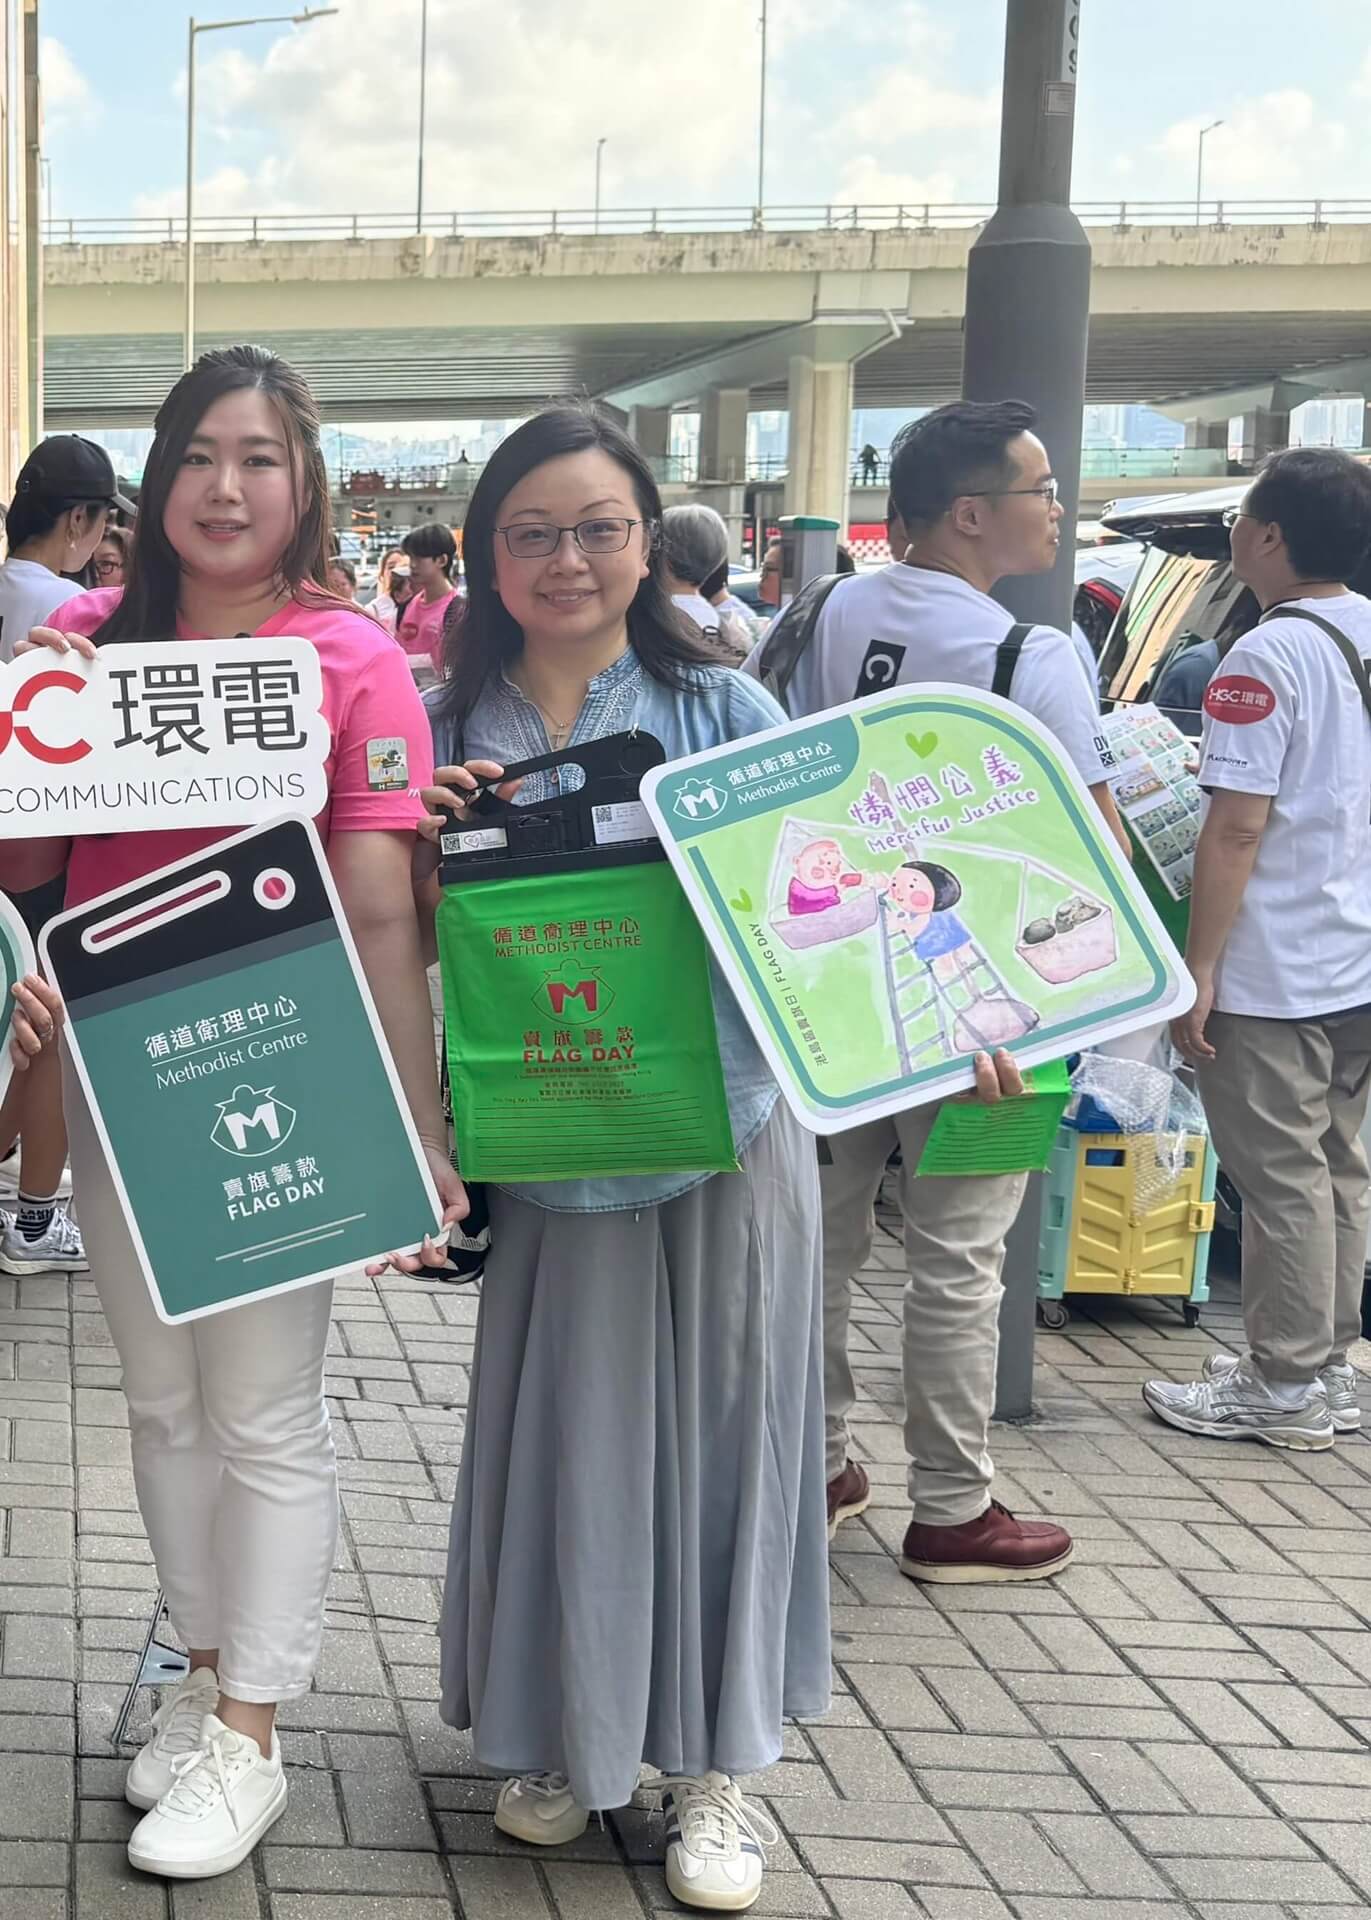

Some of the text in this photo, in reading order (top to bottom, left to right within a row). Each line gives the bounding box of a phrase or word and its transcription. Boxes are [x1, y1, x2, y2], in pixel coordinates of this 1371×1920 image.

[109, 658, 307, 758] 環電
[1208, 687, 1240, 703] HGC
[736, 763, 842, 805] Methodist Centre
[867, 789, 1038, 854] Merciful Justice
[495, 935, 642, 958] METHODIST CENTRE
[748, 923, 769, 947] DAY
[762, 949, 787, 984] FLAG
[155, 1030, 309, 1090] Methodist Centre
[523, 1045, 635, 1064] FLAG DAY
[222, 1155, 320, 1201] 賣旗籌款
[227, 1177, 326, 1221] FLAG DAY
